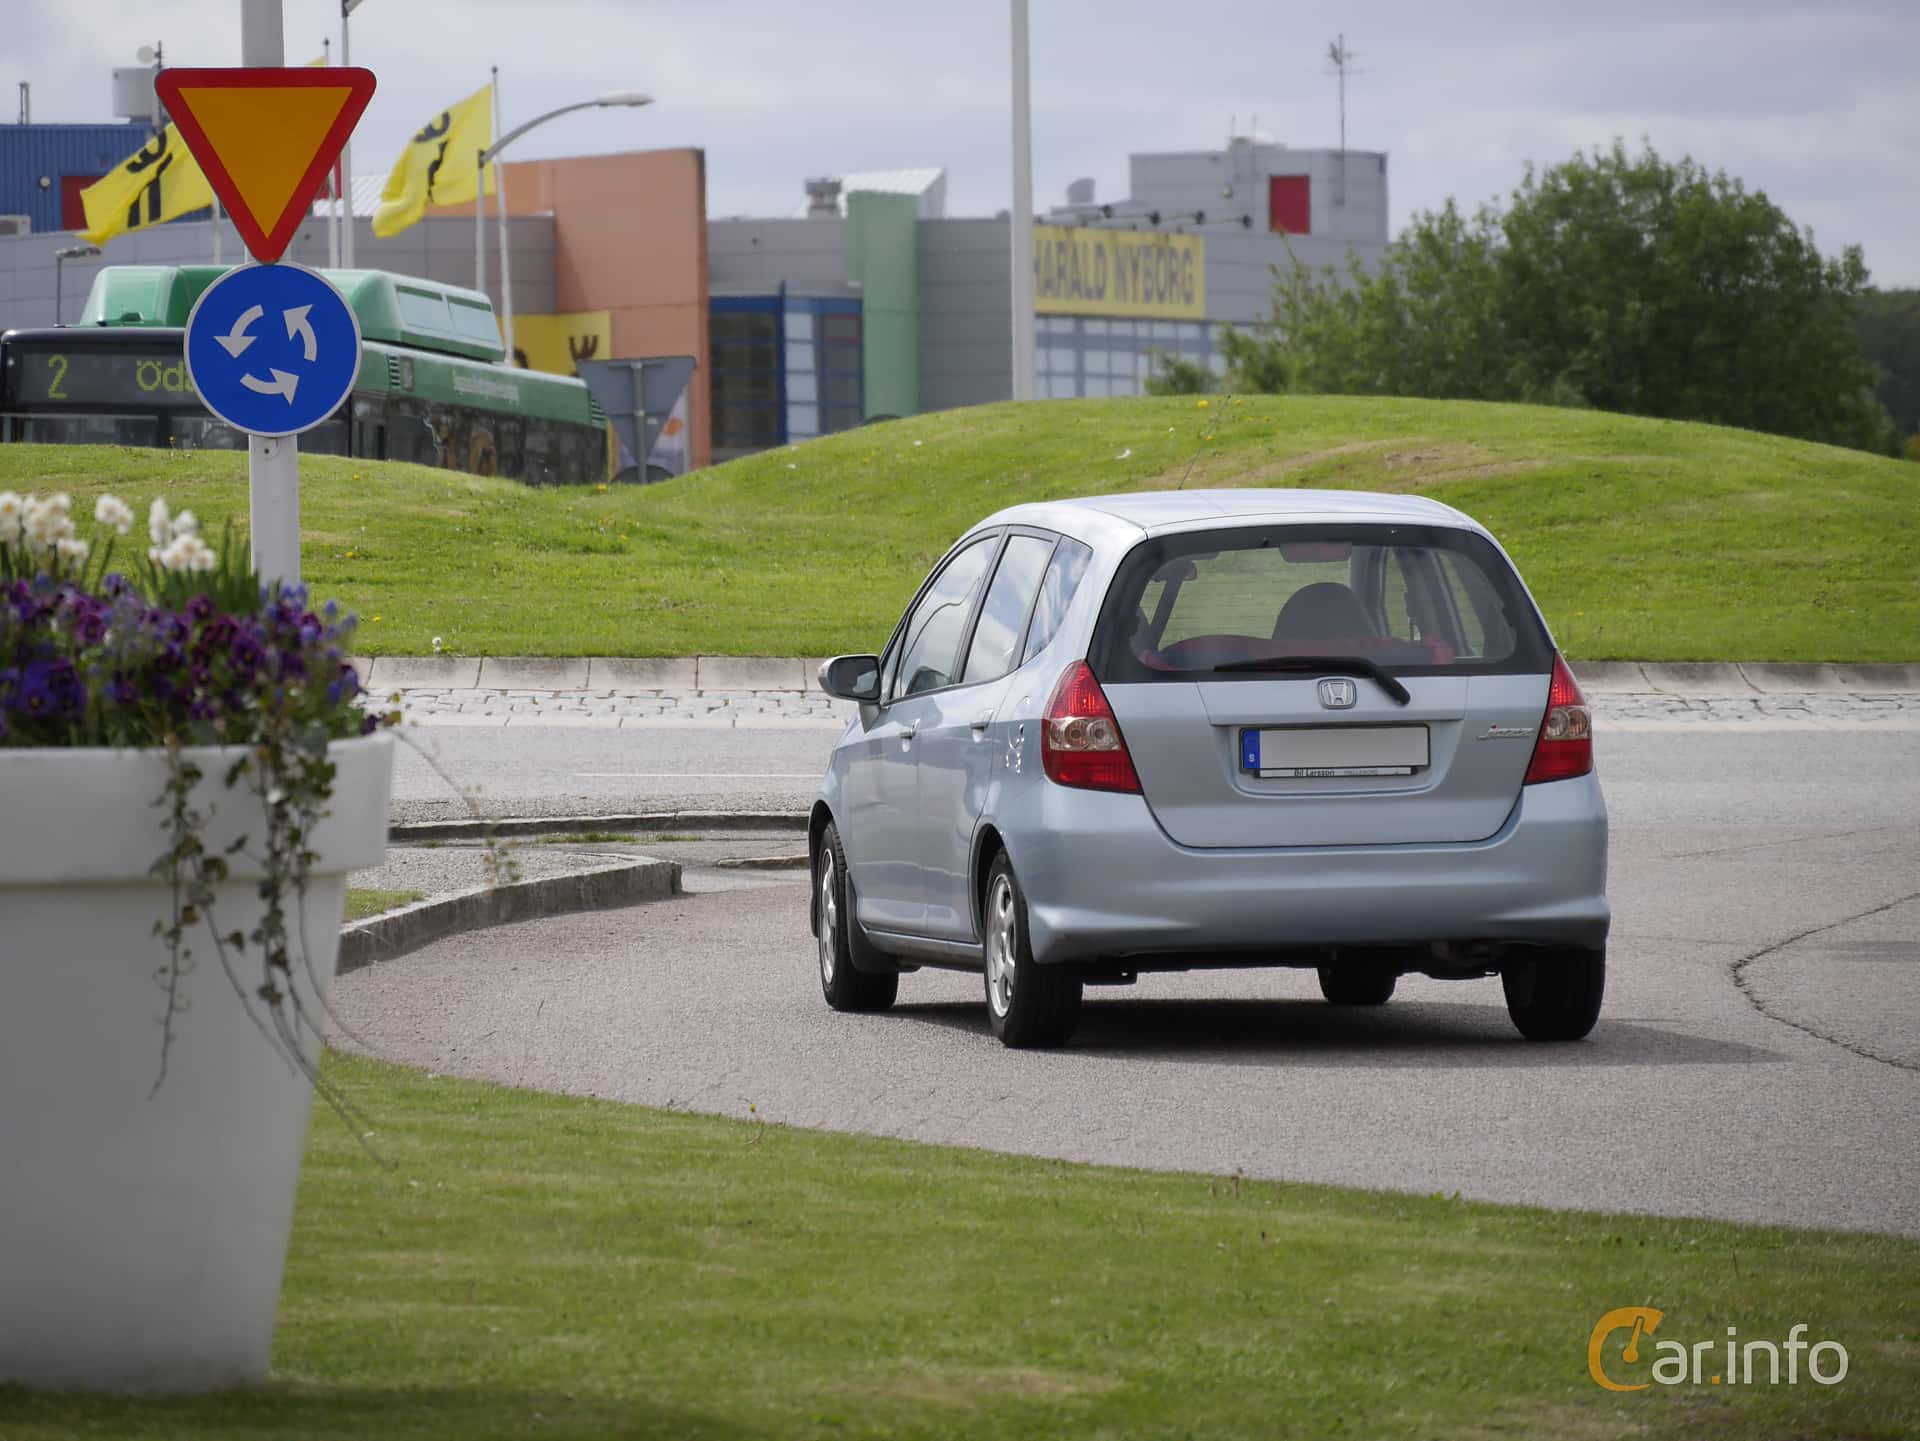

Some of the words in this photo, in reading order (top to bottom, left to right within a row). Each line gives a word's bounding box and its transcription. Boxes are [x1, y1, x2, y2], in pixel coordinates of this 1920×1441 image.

[1114, 244, 1194, 305] NYBORG
[47, 353, 68, 400] 2
[1248, 753, 1256, 763] S
